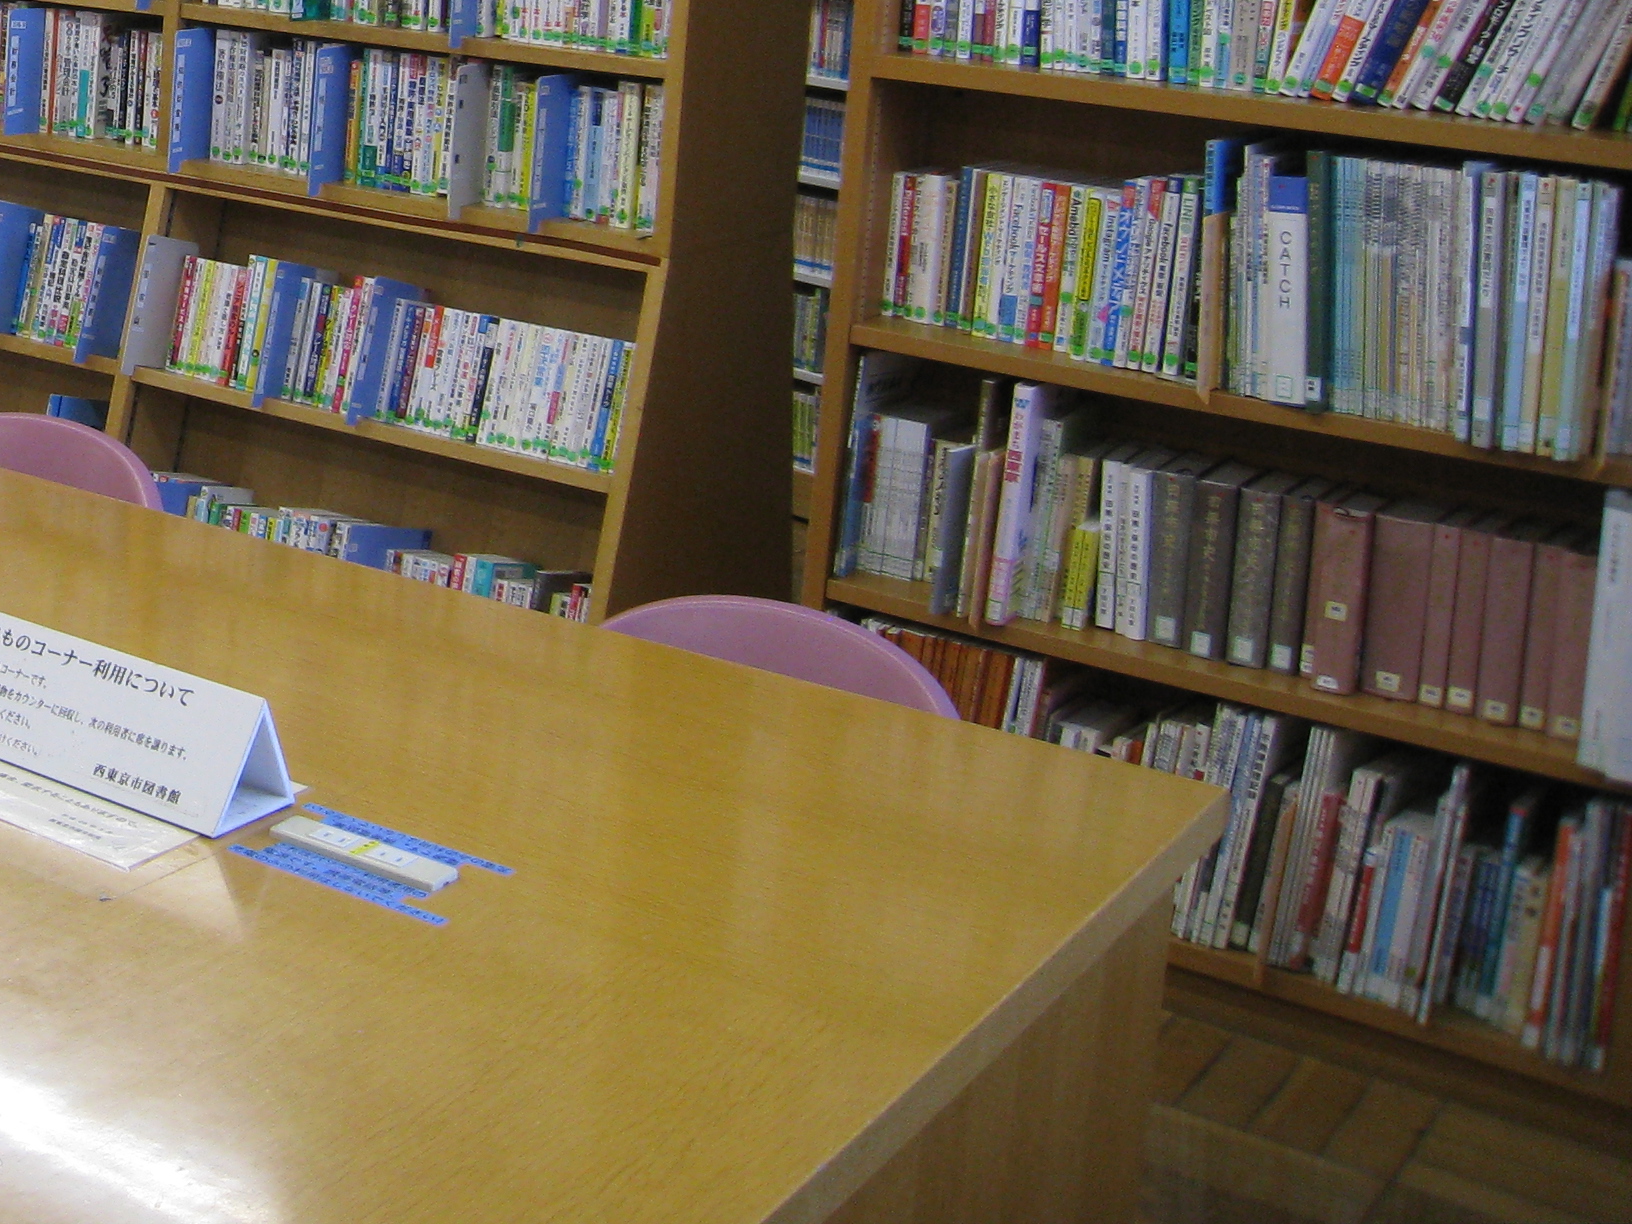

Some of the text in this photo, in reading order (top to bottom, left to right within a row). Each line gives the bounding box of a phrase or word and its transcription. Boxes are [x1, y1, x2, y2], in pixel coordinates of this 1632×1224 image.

[1278, 230, 1293, 311] CATCH
[91, 761, 182, 806] 西東京市図書館
